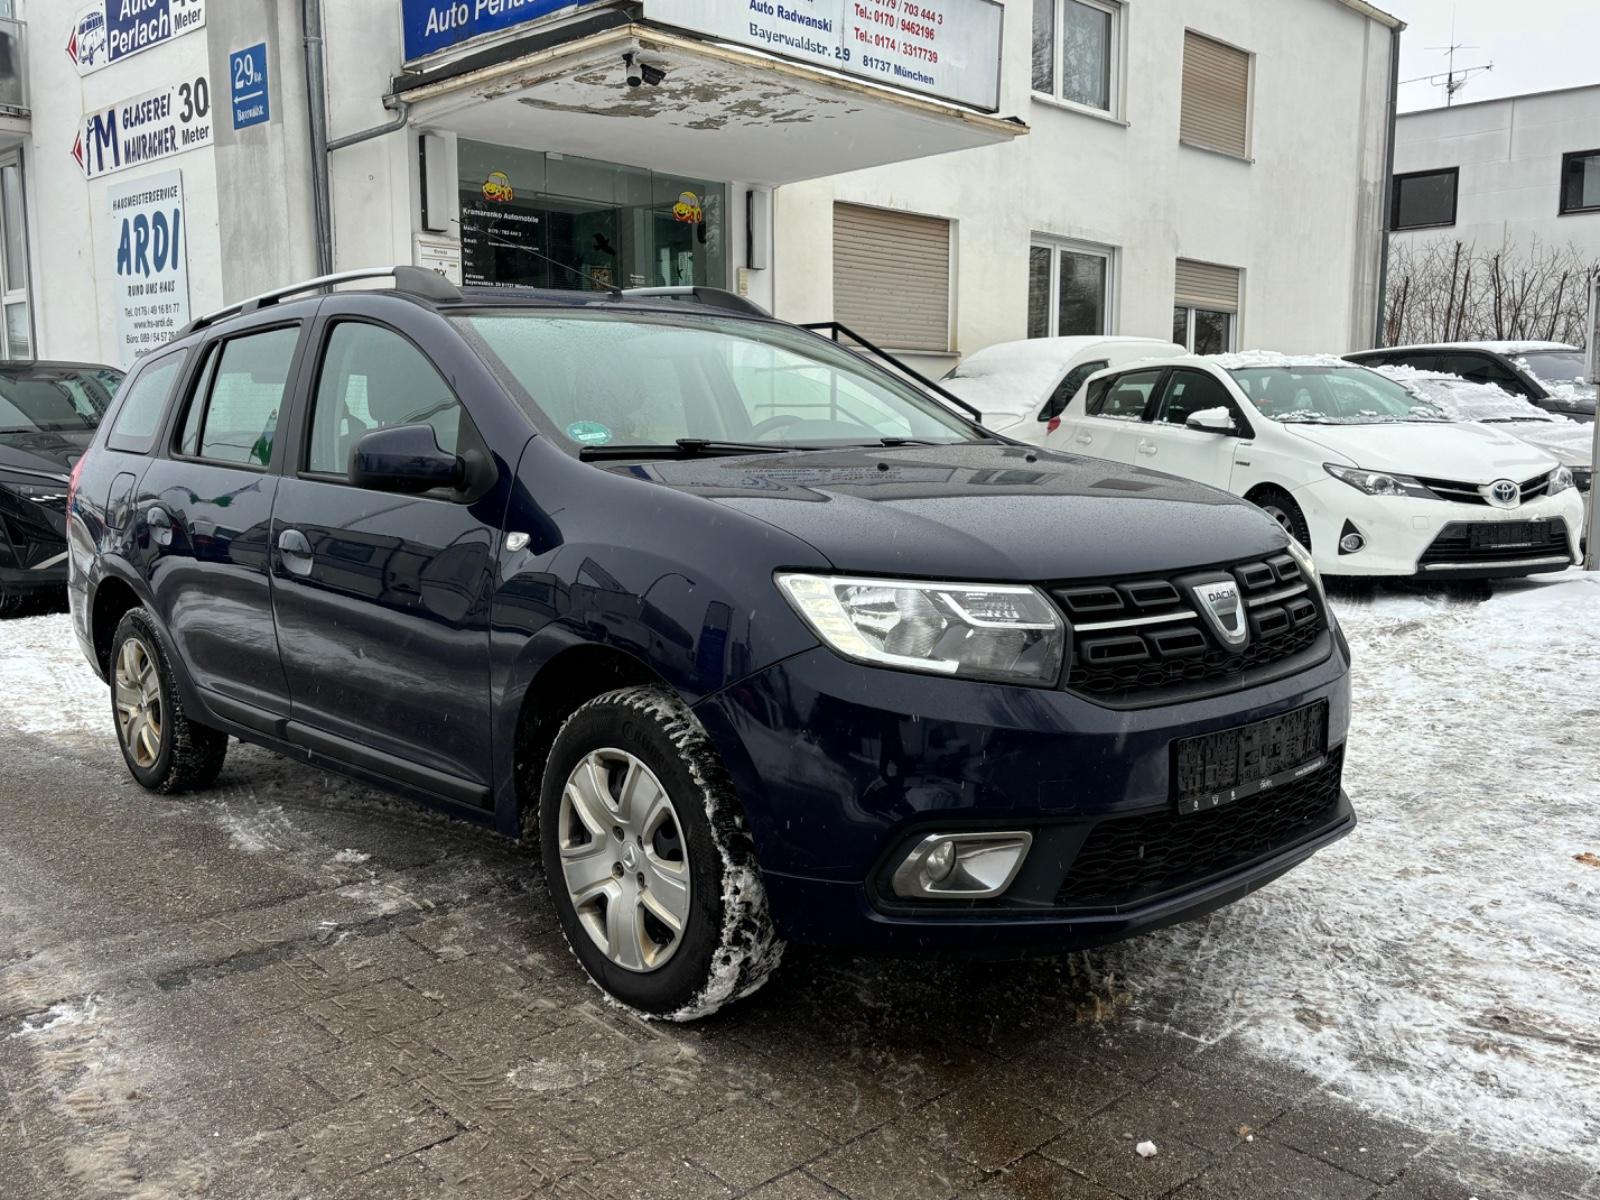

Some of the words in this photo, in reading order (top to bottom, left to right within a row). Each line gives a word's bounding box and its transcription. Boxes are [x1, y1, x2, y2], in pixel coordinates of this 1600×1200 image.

[174, 7, 202, 32] Meter
[425, 2, 468, 37] Auto
[749, 0, 774, 15] Auto
[777, 5, 832, 33] Radwanski
[854, 3, 872, 20] Tel.:
[874, 10, 895, 28] 0170
[901, 18, 935, 40] 9462196
[904, 2, 919, 17] 703
[920, 8, 936, 23] 444
[937, 14, 943, 25] 3
[109, 8, 169, 58] Perlach
[854, 27, 873, 44] Tel.:
[875, 34, 896, 51] 0174
[902, 42, 938, 63] 3317739
[749, 22, 831, 57] Bayerwaldstr.
[835, 46, 851, 61] 29
[863, 55, 891, 72] 81737
[894, 63, 935, 85] München
[234, 54, 254, 90] 29
[122, 93, 171, 130] GLASEREI
[178, 76, 209, 123] 30
[124, 125, 178, 165] MAURACHER
[181, 125, 209, 145] Meter
[112, 185, 178, 211] HAUSMEISTERSERVICE
[503, 213, 539, 224] Automobile
[117, 208, 180, 279] ARDI
[128, 284, 145, 297] RUND
[146, 282, 158, 295] UMS
[159, 280, 175, 293] HAUS
[1208, 589, 1237, 602] DACIA
